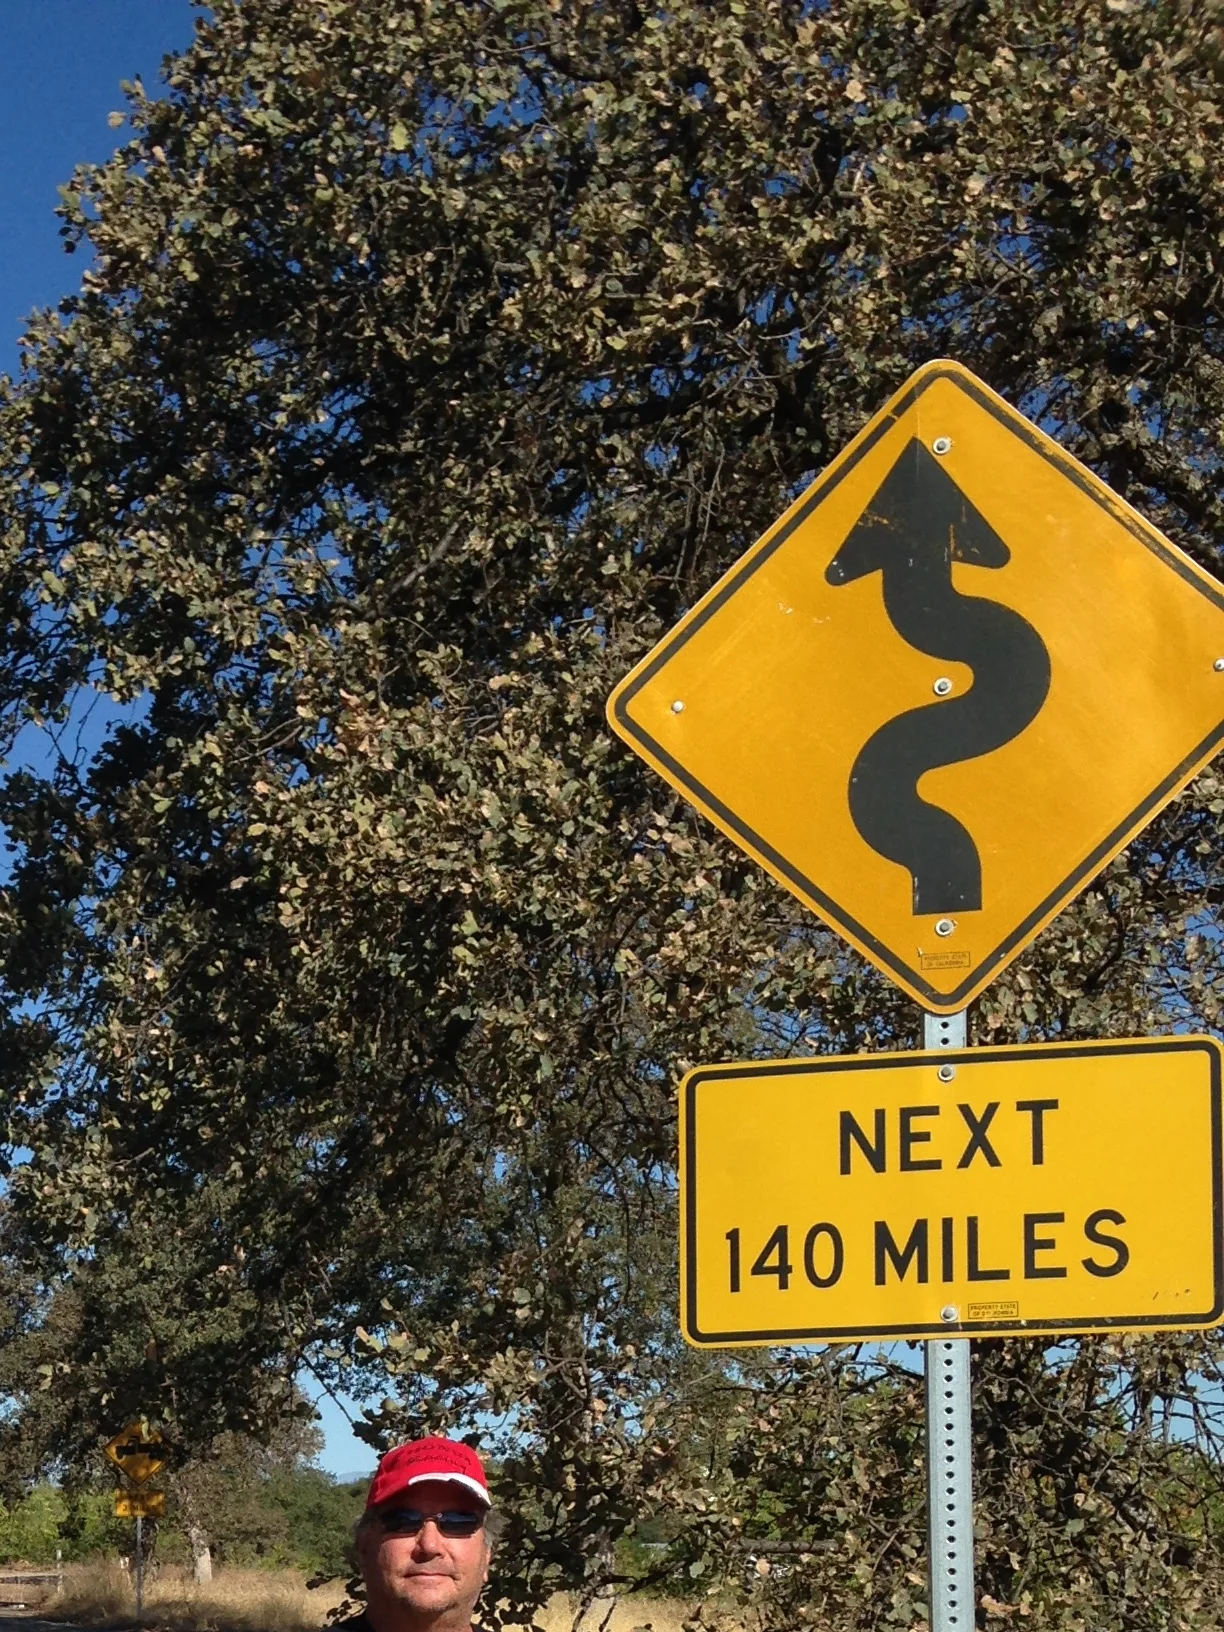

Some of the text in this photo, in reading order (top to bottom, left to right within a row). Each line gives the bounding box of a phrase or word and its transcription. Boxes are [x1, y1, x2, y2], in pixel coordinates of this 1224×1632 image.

[839, 1098, 1059, 1176] NEXT
[725, 1208, 1130, 1293] 140 MILES
